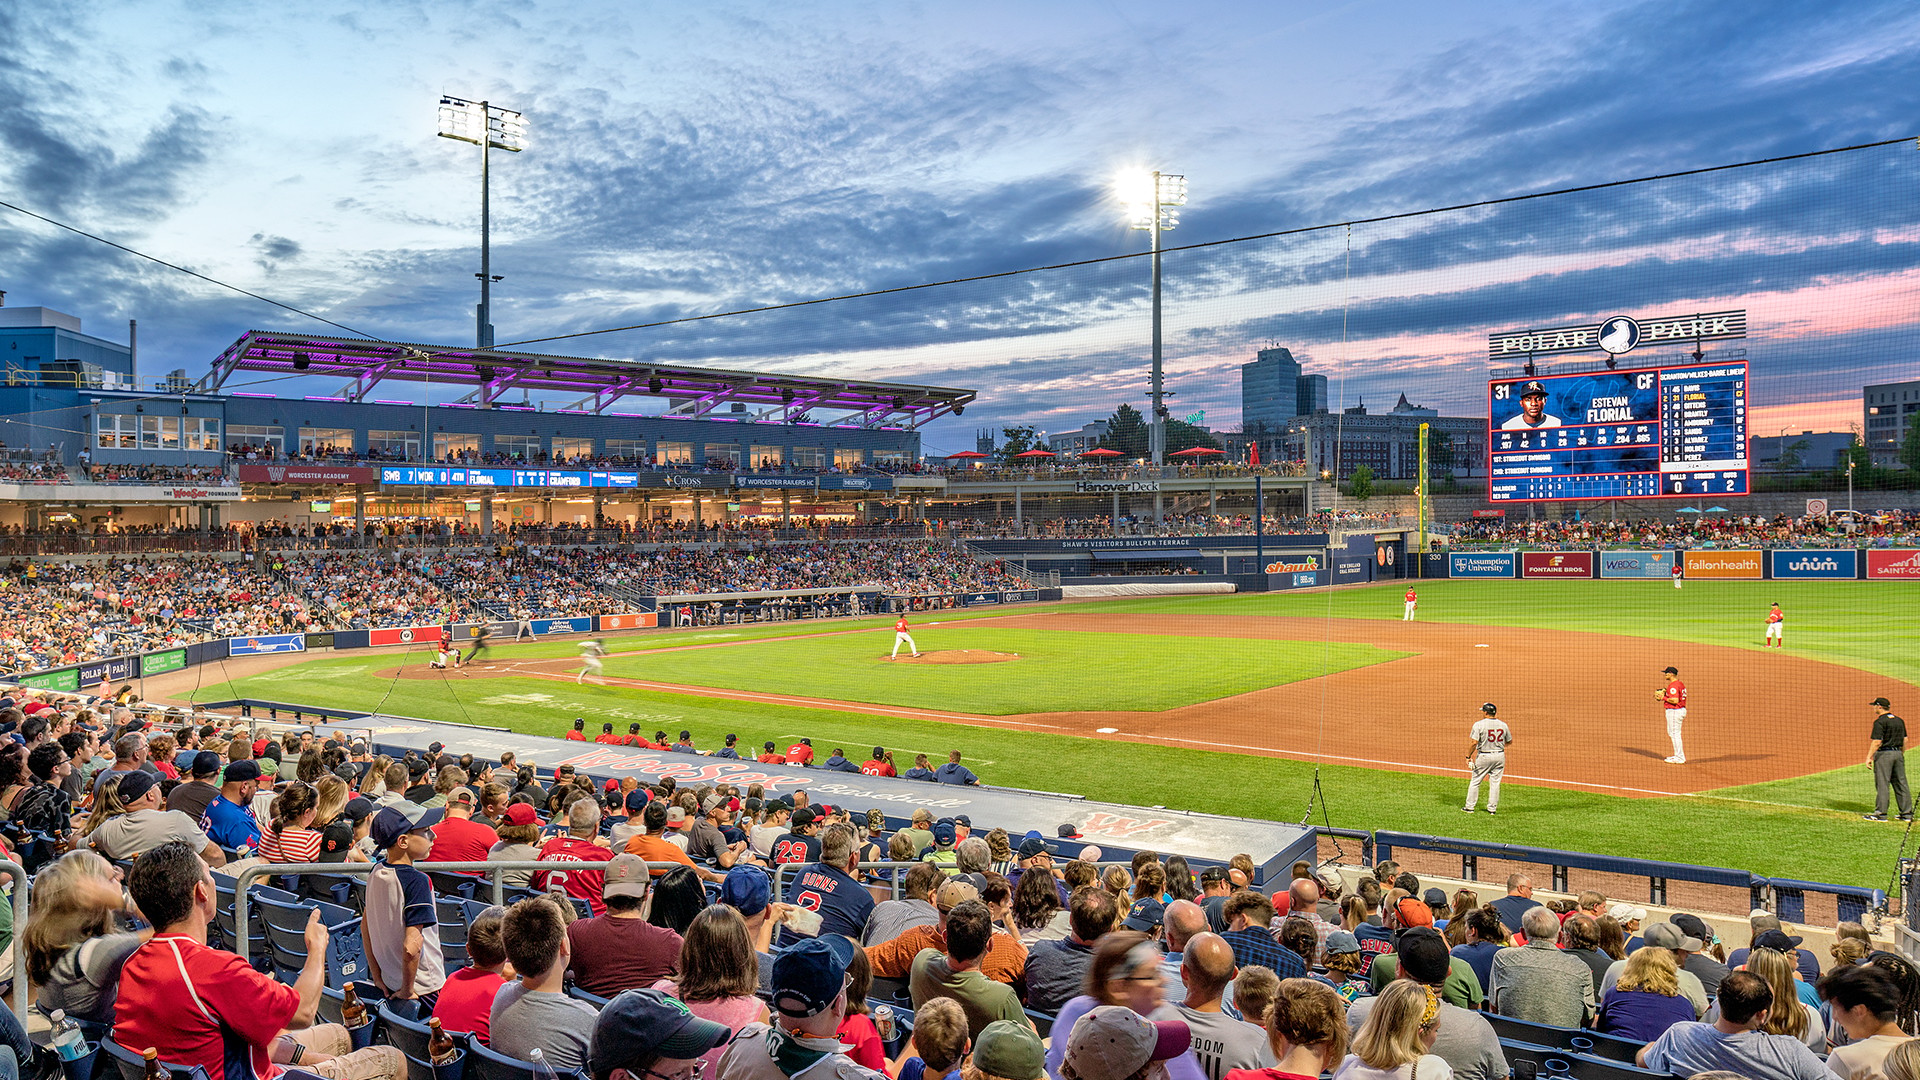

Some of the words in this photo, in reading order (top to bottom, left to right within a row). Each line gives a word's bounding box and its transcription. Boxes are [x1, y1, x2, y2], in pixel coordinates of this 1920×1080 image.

[1501, 330, 1589, 354] POLAR
[1650, 316, 1731, 341] PARK
[1637, 373, 1654, 390] CF
[1735, 381, 1744, 389] LF
[1494, 384, 1511, 400] 31
[1672, 394, 1680, 402] 31
[1683, 393, 1706, 401] FLORIAL
[1592, 396, 1629, 409] ESTEVAN
[1587, 407, 1634, 423] FLORIAL
[1520, 440, 1529, 448] 42
[267, 466, 286, 481] W
[384, 470, 401, 481] SWB
[408, 470, 414, 481] 7
[440, 471, 447, 482] 0
[451, 472, 464, 482] 4TH
[469, 475, 495, 485] FLORIAL
[518, 476, 523, 485] 0
[529, 476, 534, 485] 1
[539, 476, 545, 485] 2
[549, 476, 581, 486] CRAWFORD
[1674, 481, 1682, 493] 0
[1701, 480, 1708, 492] 1
[1726, 479, 1735, 491] 2
[388, 505, 419, 514] NACHO
[421, 506, 440, 514] MAN
[1429, 553, 1441, 561] 330
[1468, 558, 1510, 566] Assumption
[1468, 564, 1504, 573] University
[1688, 559, 1759, 571] fallonhealth
[81, 669, 101, 680] POLAR
[1487, 728, 1504, 743] 52
[790, 746, 801, 754] 2
[549, 748, 814, 791] WooSox
[812, 784, 972, 809] Baseball
[1078, 812, 1176, 838] W
[775, 839, 809, 865] 29
[801, 872, 839, 893] DOWNS
